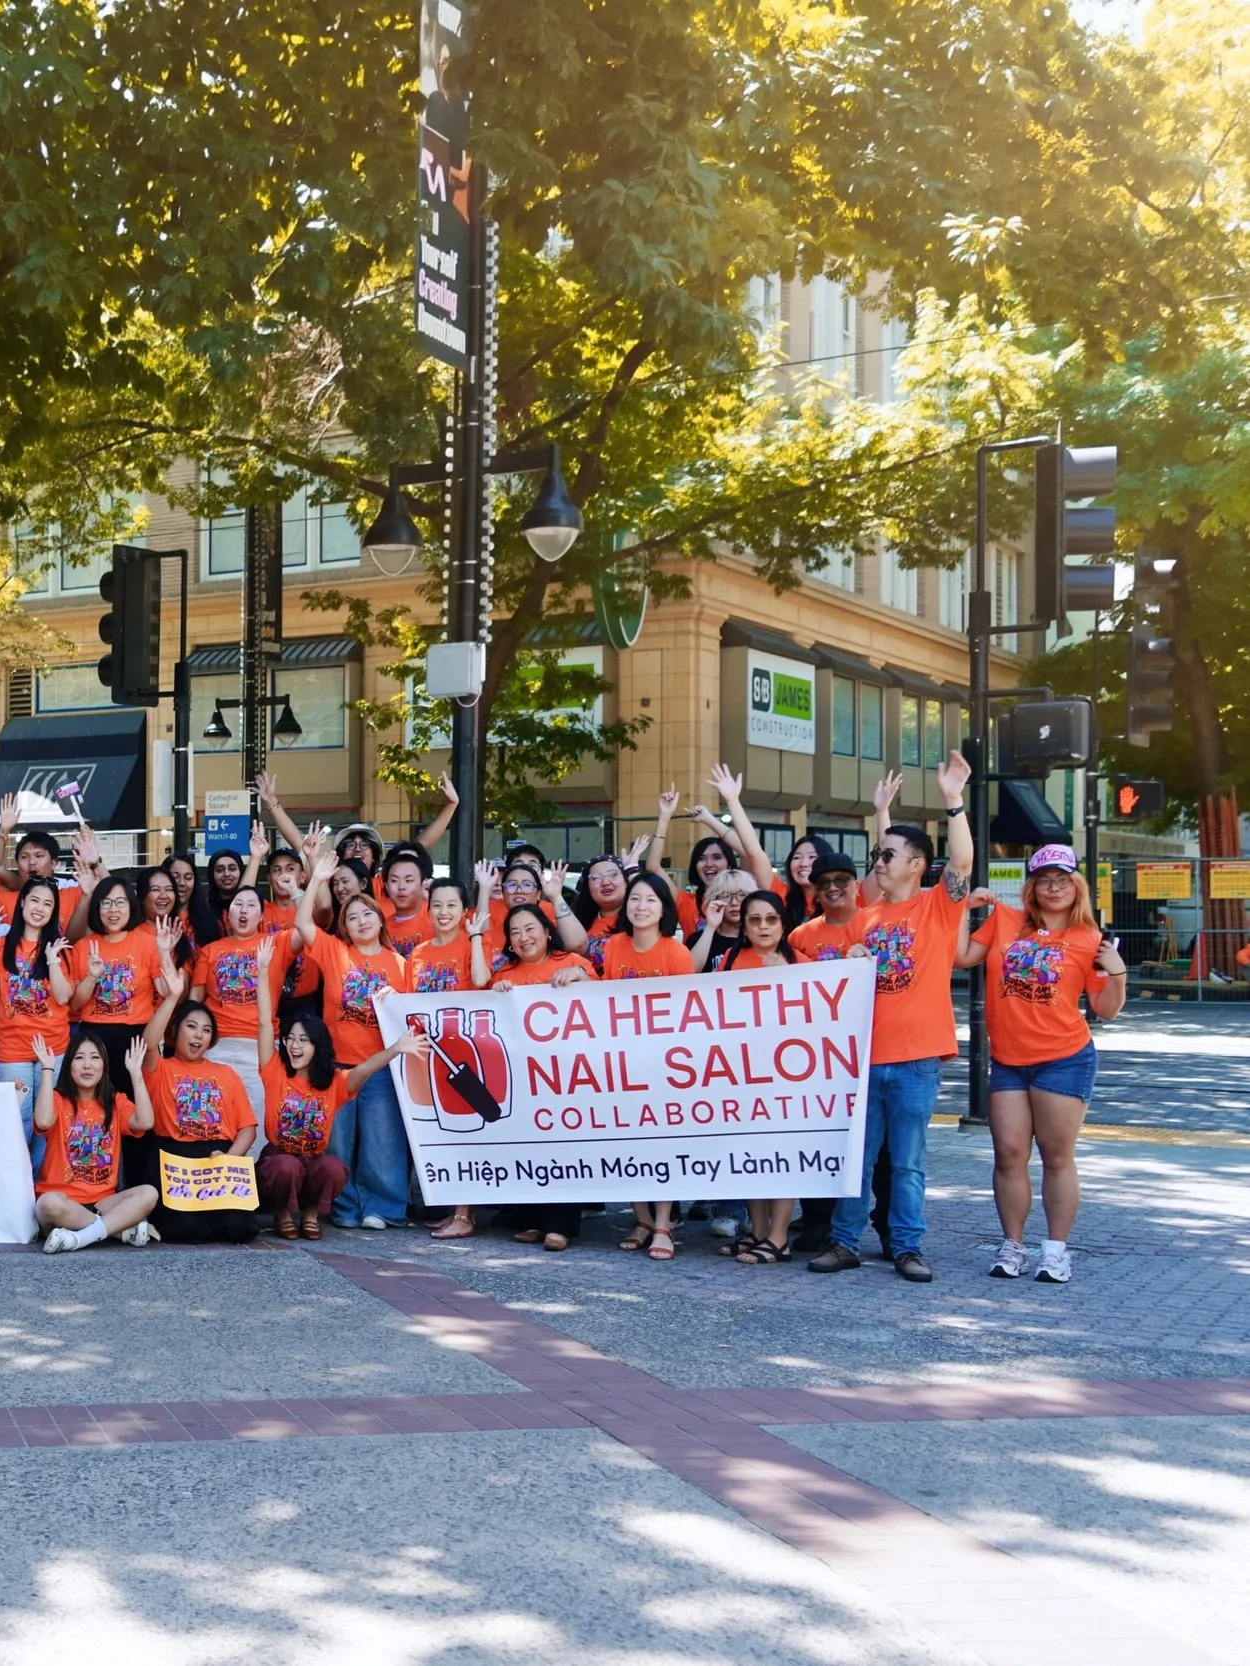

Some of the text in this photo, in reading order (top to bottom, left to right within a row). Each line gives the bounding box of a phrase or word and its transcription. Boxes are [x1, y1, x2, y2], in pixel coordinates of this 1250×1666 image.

[775, 682, 810, 712] JAMES
[751, 716, 813, 739] CONSTRUCTION
[208, 801, 230, 809] Square
[207, 832, 238, 840] Watt/I-80
[524, 978, 849, 1042] CA HEALTHY
[527, 1035, 860, 1096] NAIL SALON
[164, 1163, 179, 1174] IF
[191, 1167, 223, 1176] GOT
[227, 1166, 250, 1175] ME
[425, 1150, 845, 1187] ên Hiệp Ngành Móng Tay Lành Mạ
[165, 1174, 251, 1185] YOU GOT YOU
[167, 1184, 193, 1198] We
[196, 1184, 229, 1201] Got
